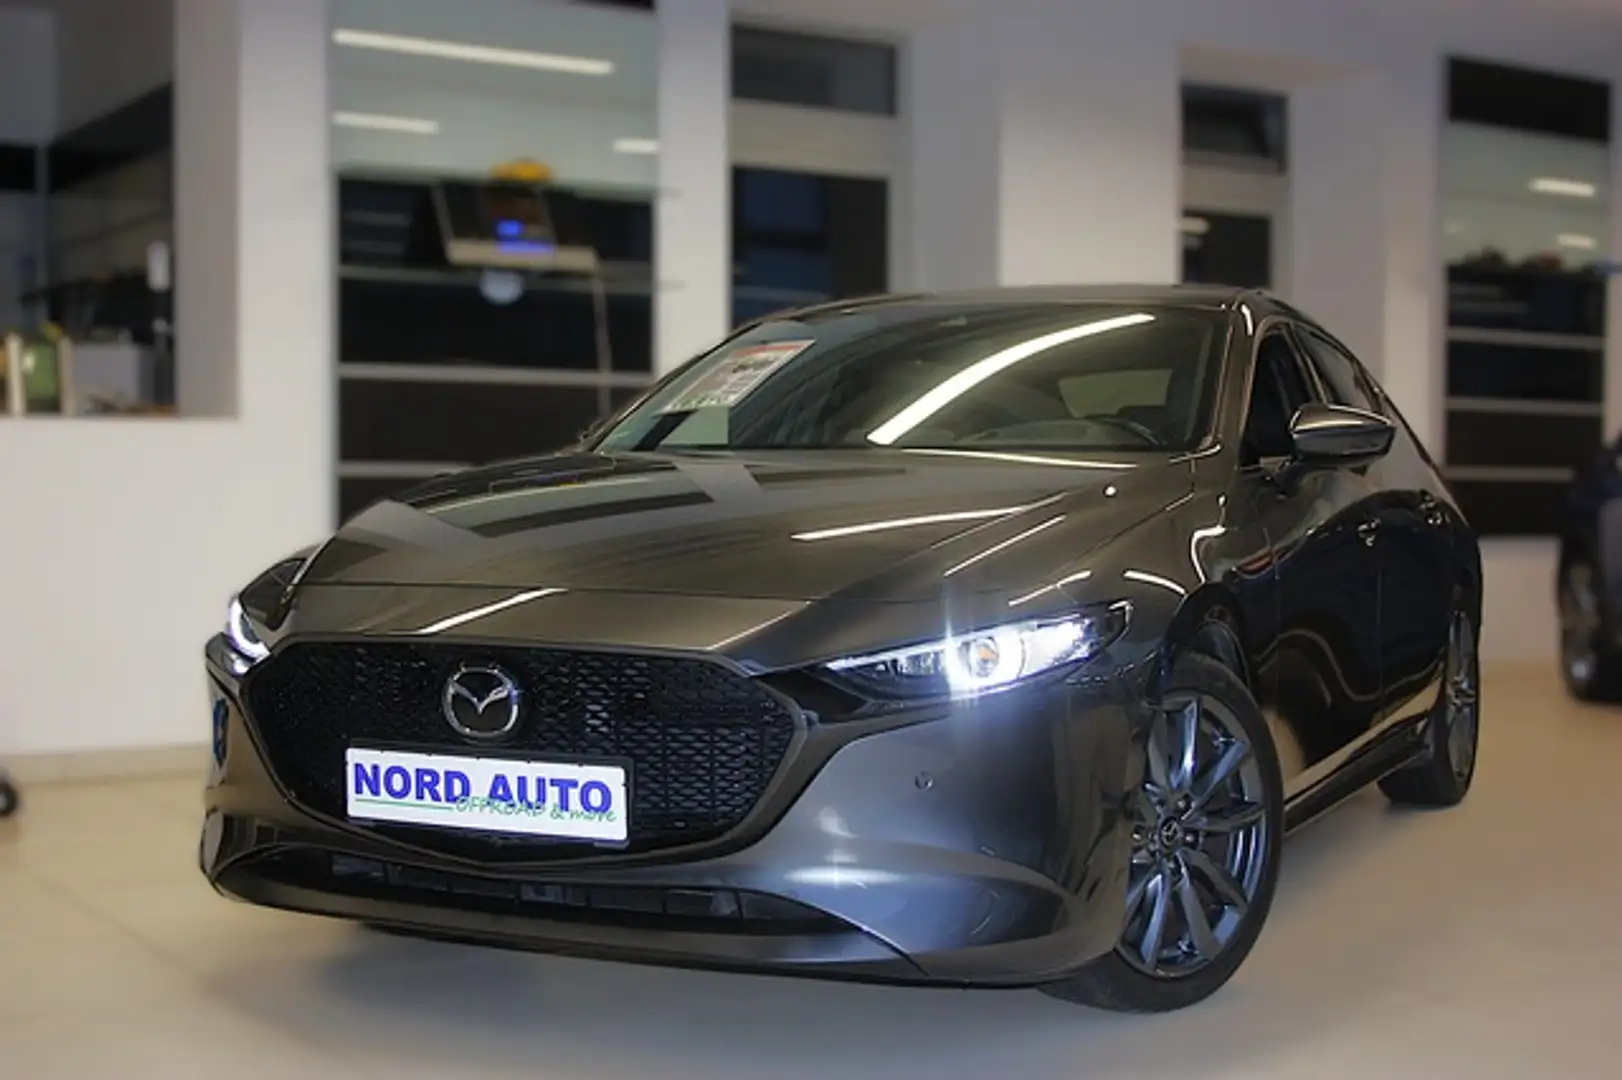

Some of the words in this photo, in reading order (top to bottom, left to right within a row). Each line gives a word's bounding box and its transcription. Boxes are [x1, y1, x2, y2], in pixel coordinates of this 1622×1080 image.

[353, 763, 471, 803] NORD
[488, 774, 613, 814] AUTO
[455, 796, 545, 818] OFFROAD
[550, 804, 565, 820] &
[570, 808, 617, 822] more
